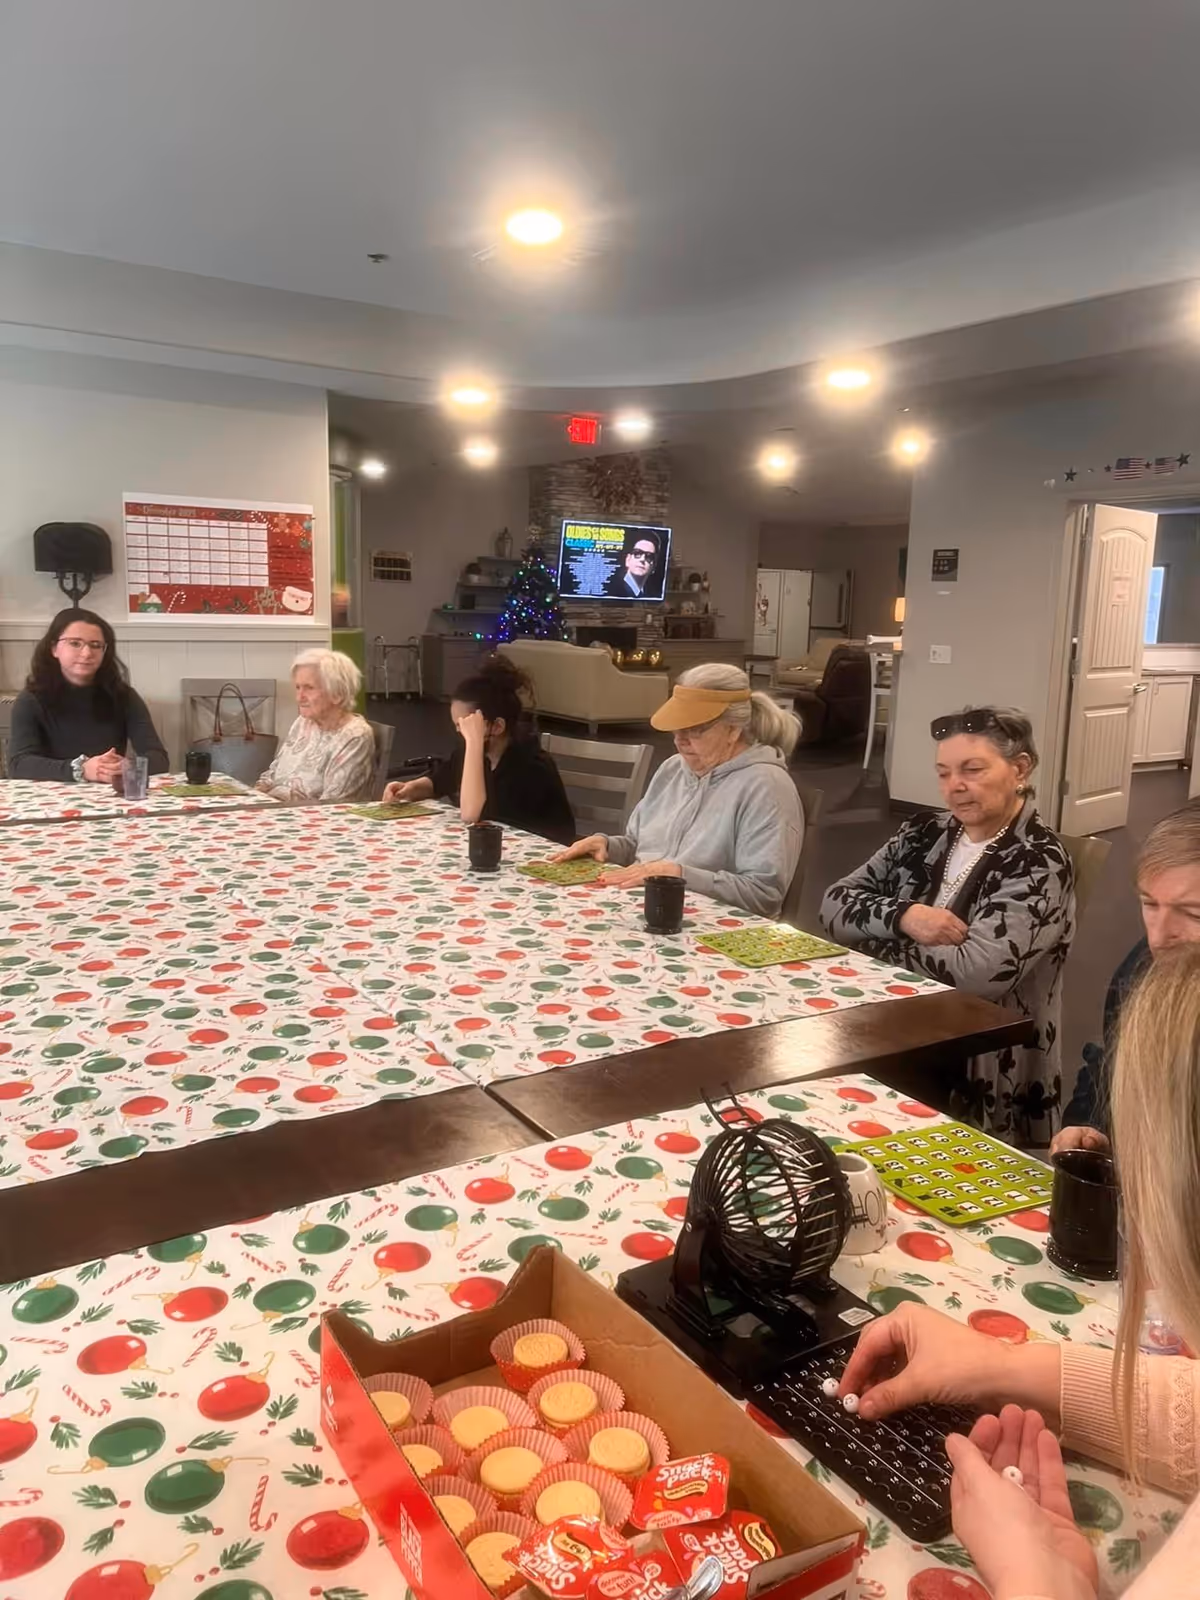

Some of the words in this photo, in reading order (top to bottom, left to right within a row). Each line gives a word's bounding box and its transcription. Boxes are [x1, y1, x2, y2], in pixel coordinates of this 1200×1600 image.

[932, 1188, 954, 1199] 20
[983, 1197, 1003, 1207] 12
[656, 1457, 714, 1481] Snack
[667, 1467, 711, 1488] pack
[703, 1531, 749, 1584] Snack
[721, 1527, 759, 1570] pack
[518, 1550, 576, 1590] Snack
